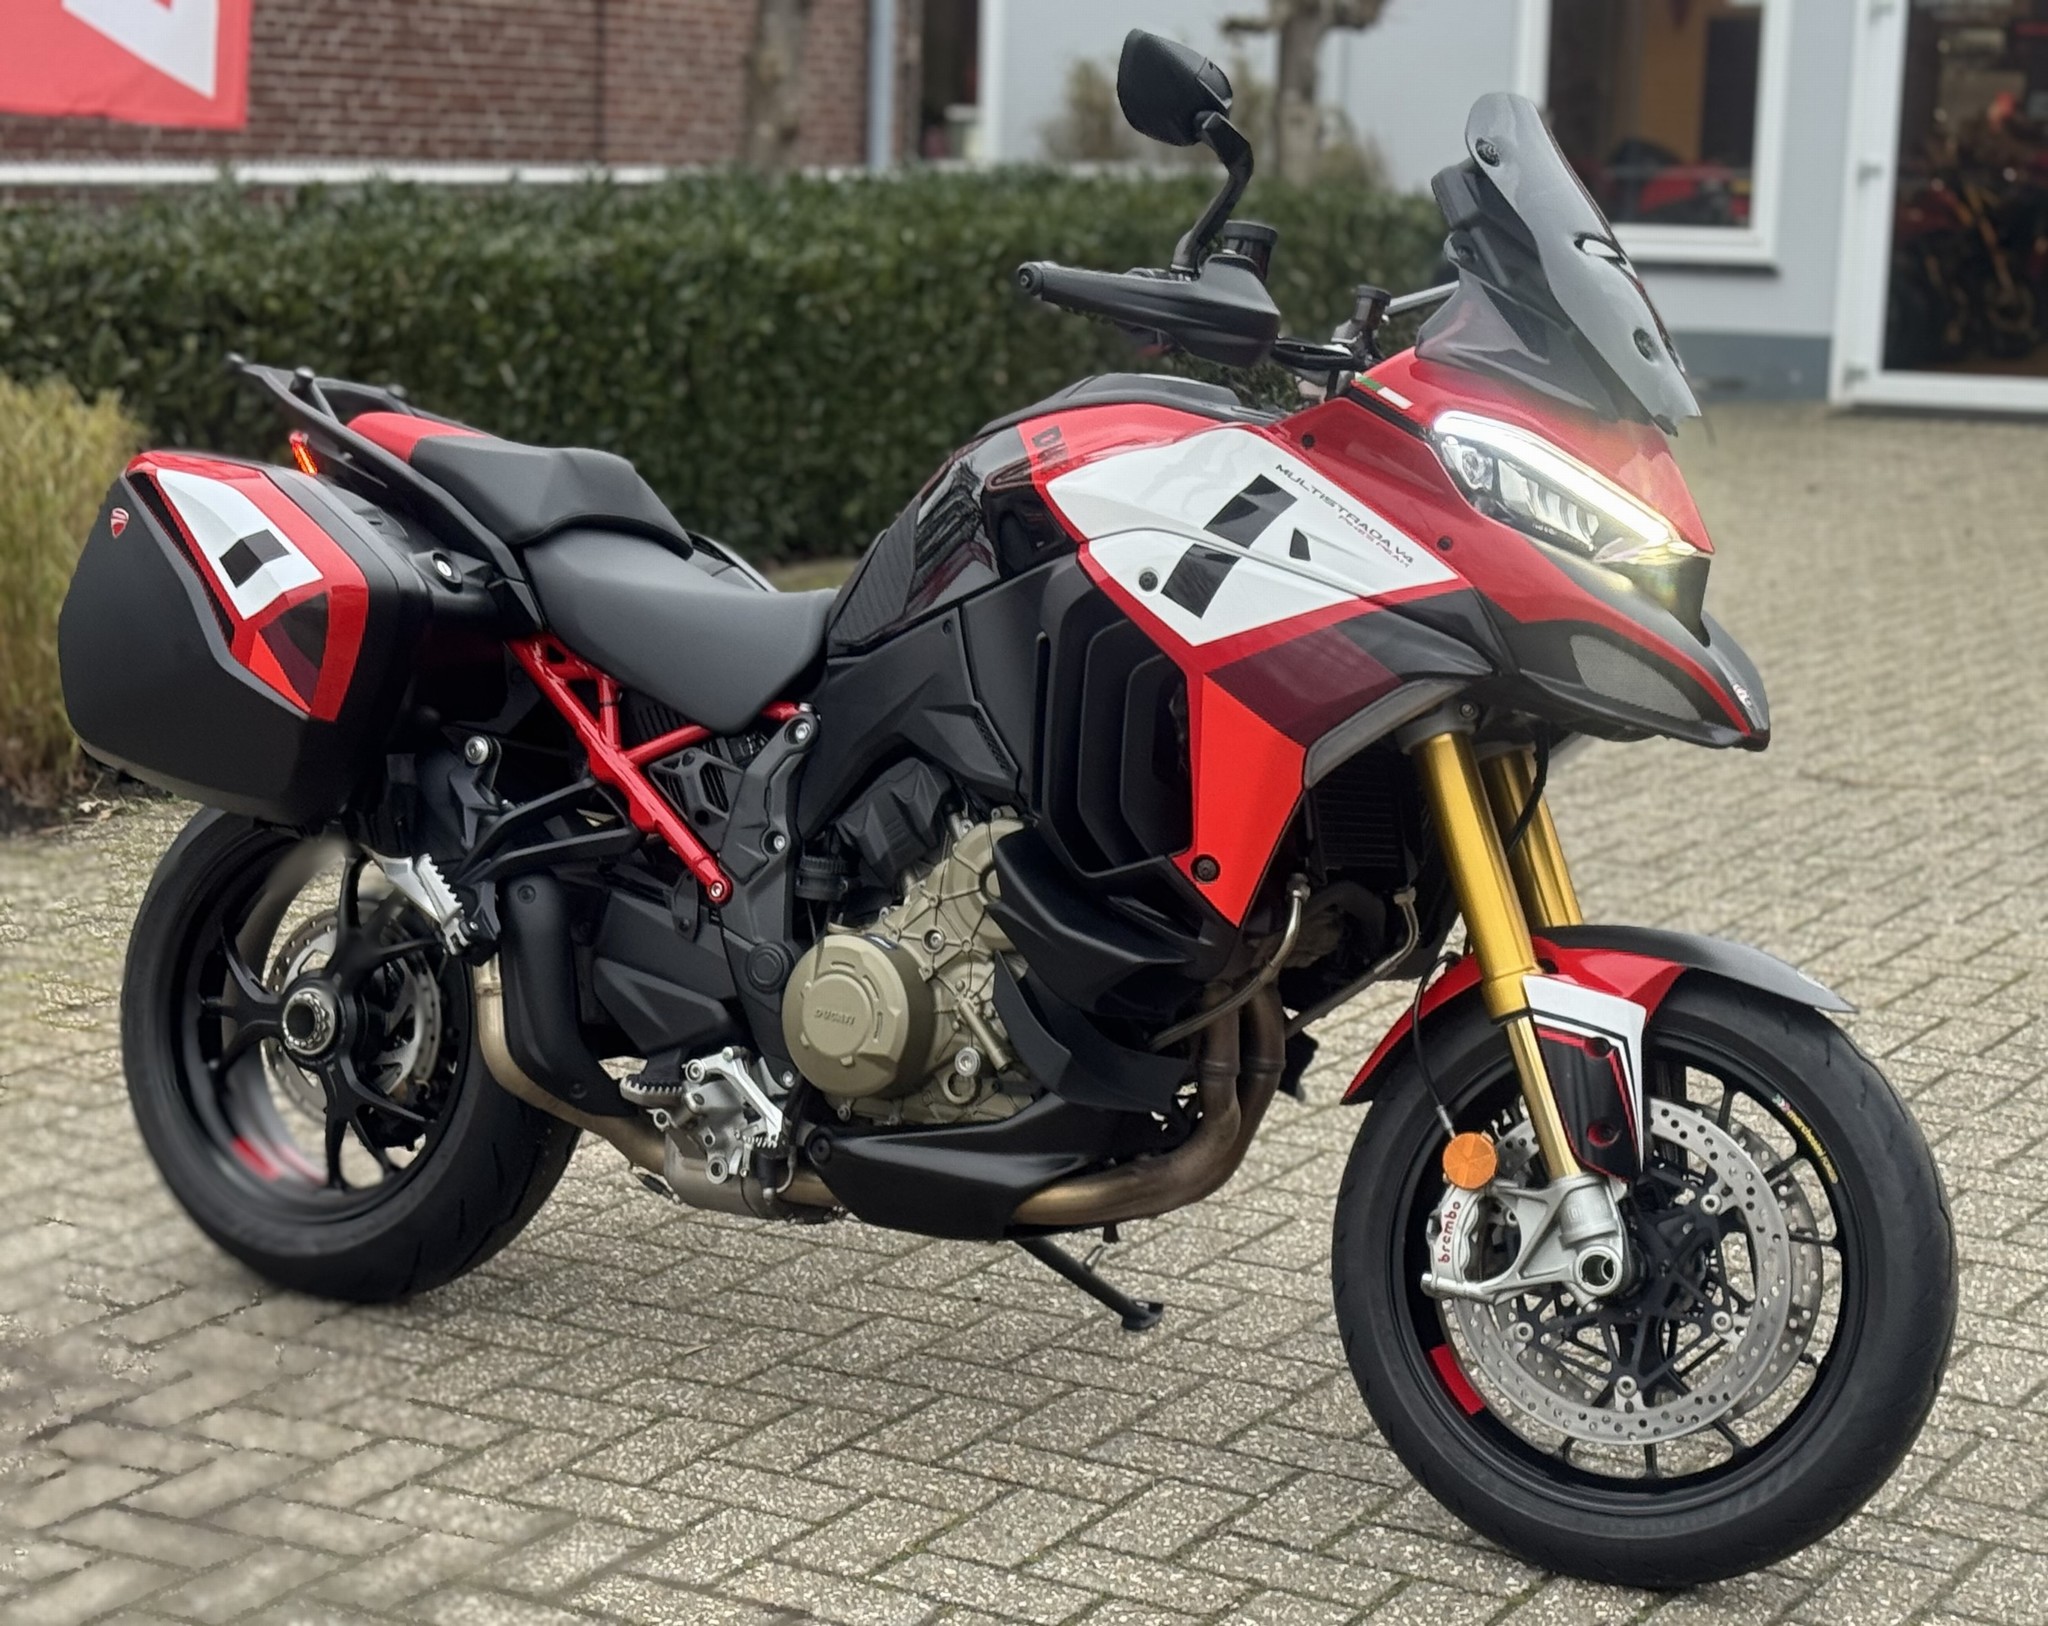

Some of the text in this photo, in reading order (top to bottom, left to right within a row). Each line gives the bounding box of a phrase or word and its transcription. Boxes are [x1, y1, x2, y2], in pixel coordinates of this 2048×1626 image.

[1276, 464, 1414, 563] MULTISTRADA V4
[814, 1009, 856, 1025] DUCATI
[1438, 1201, 1461, 1264] brembo
